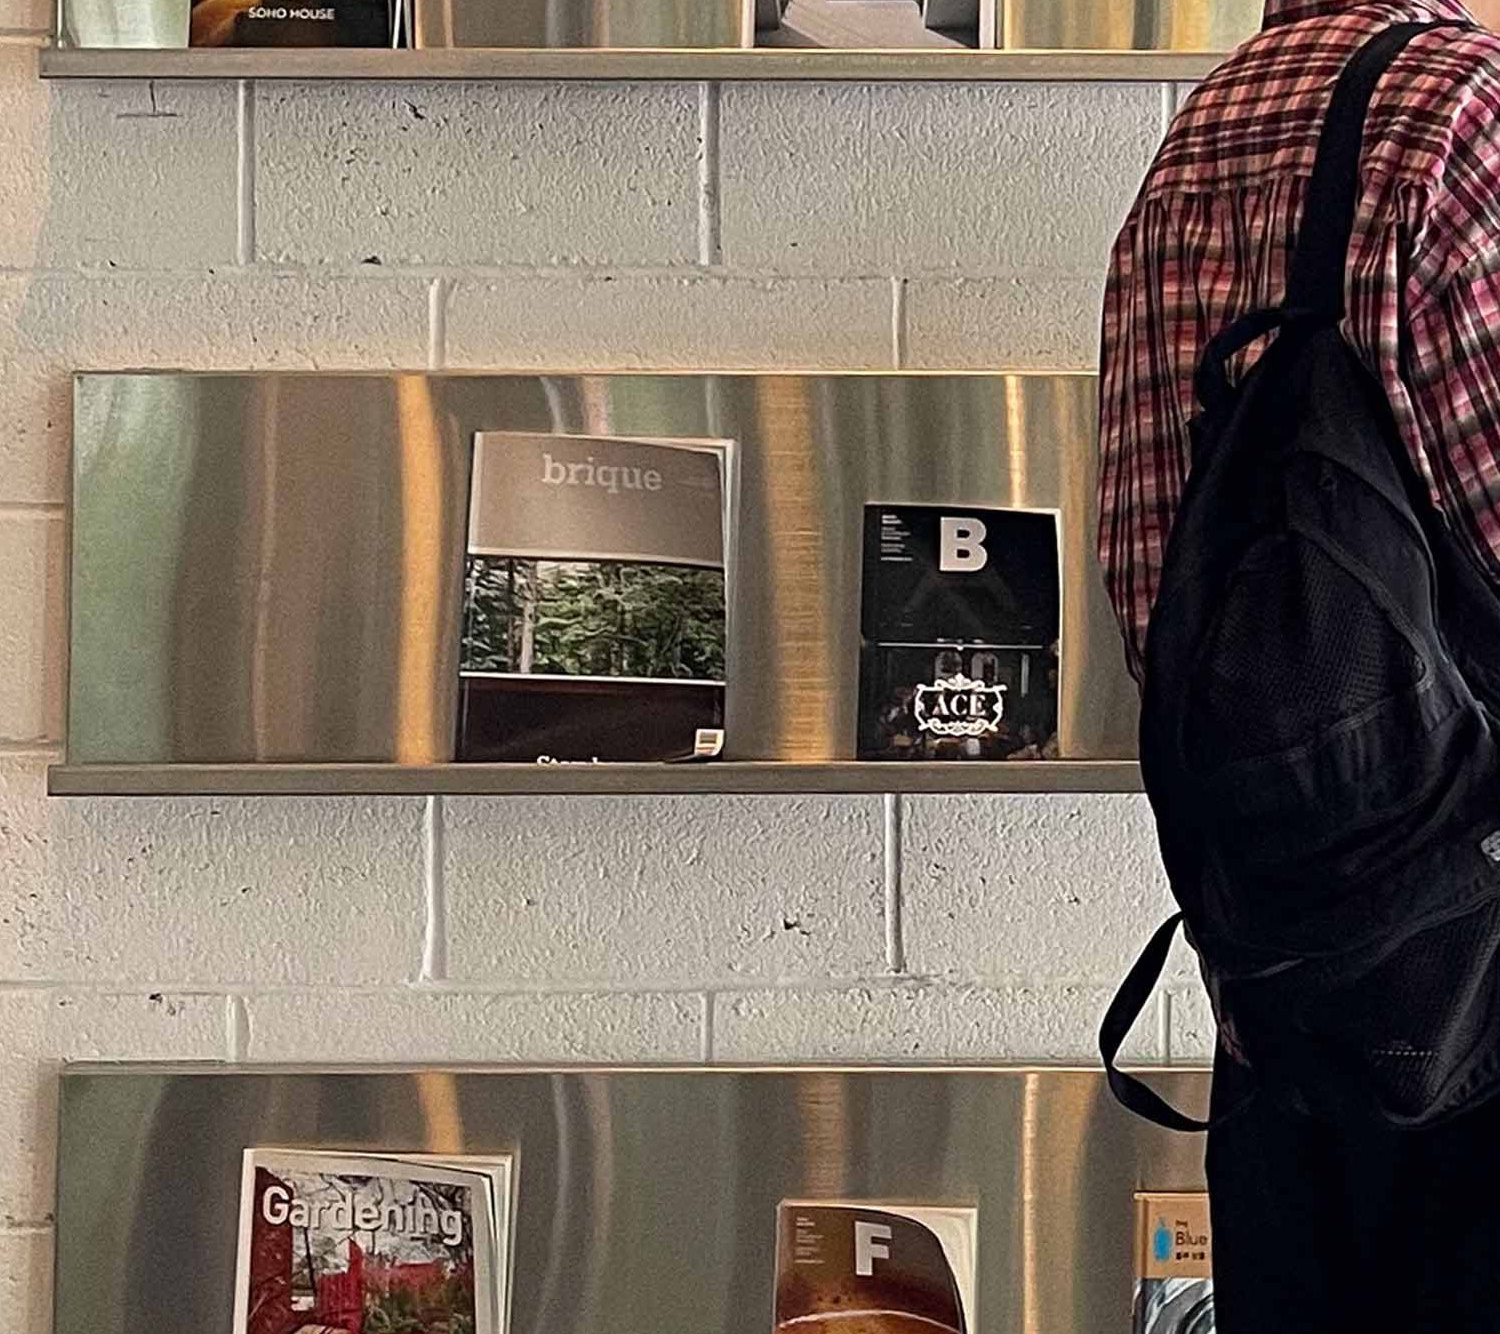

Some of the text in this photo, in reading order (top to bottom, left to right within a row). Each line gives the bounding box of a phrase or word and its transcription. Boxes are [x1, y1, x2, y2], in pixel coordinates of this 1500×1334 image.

[249, 7, 335, 20] SOHO HOUSE
[542, 453, 664, 494] brique
[940, 516, 988, 572] B
[932, 694, 987, 716] ACE
[262, 1185, 463, 1246] Gardening
[855, 1221, 892, 1276] F
